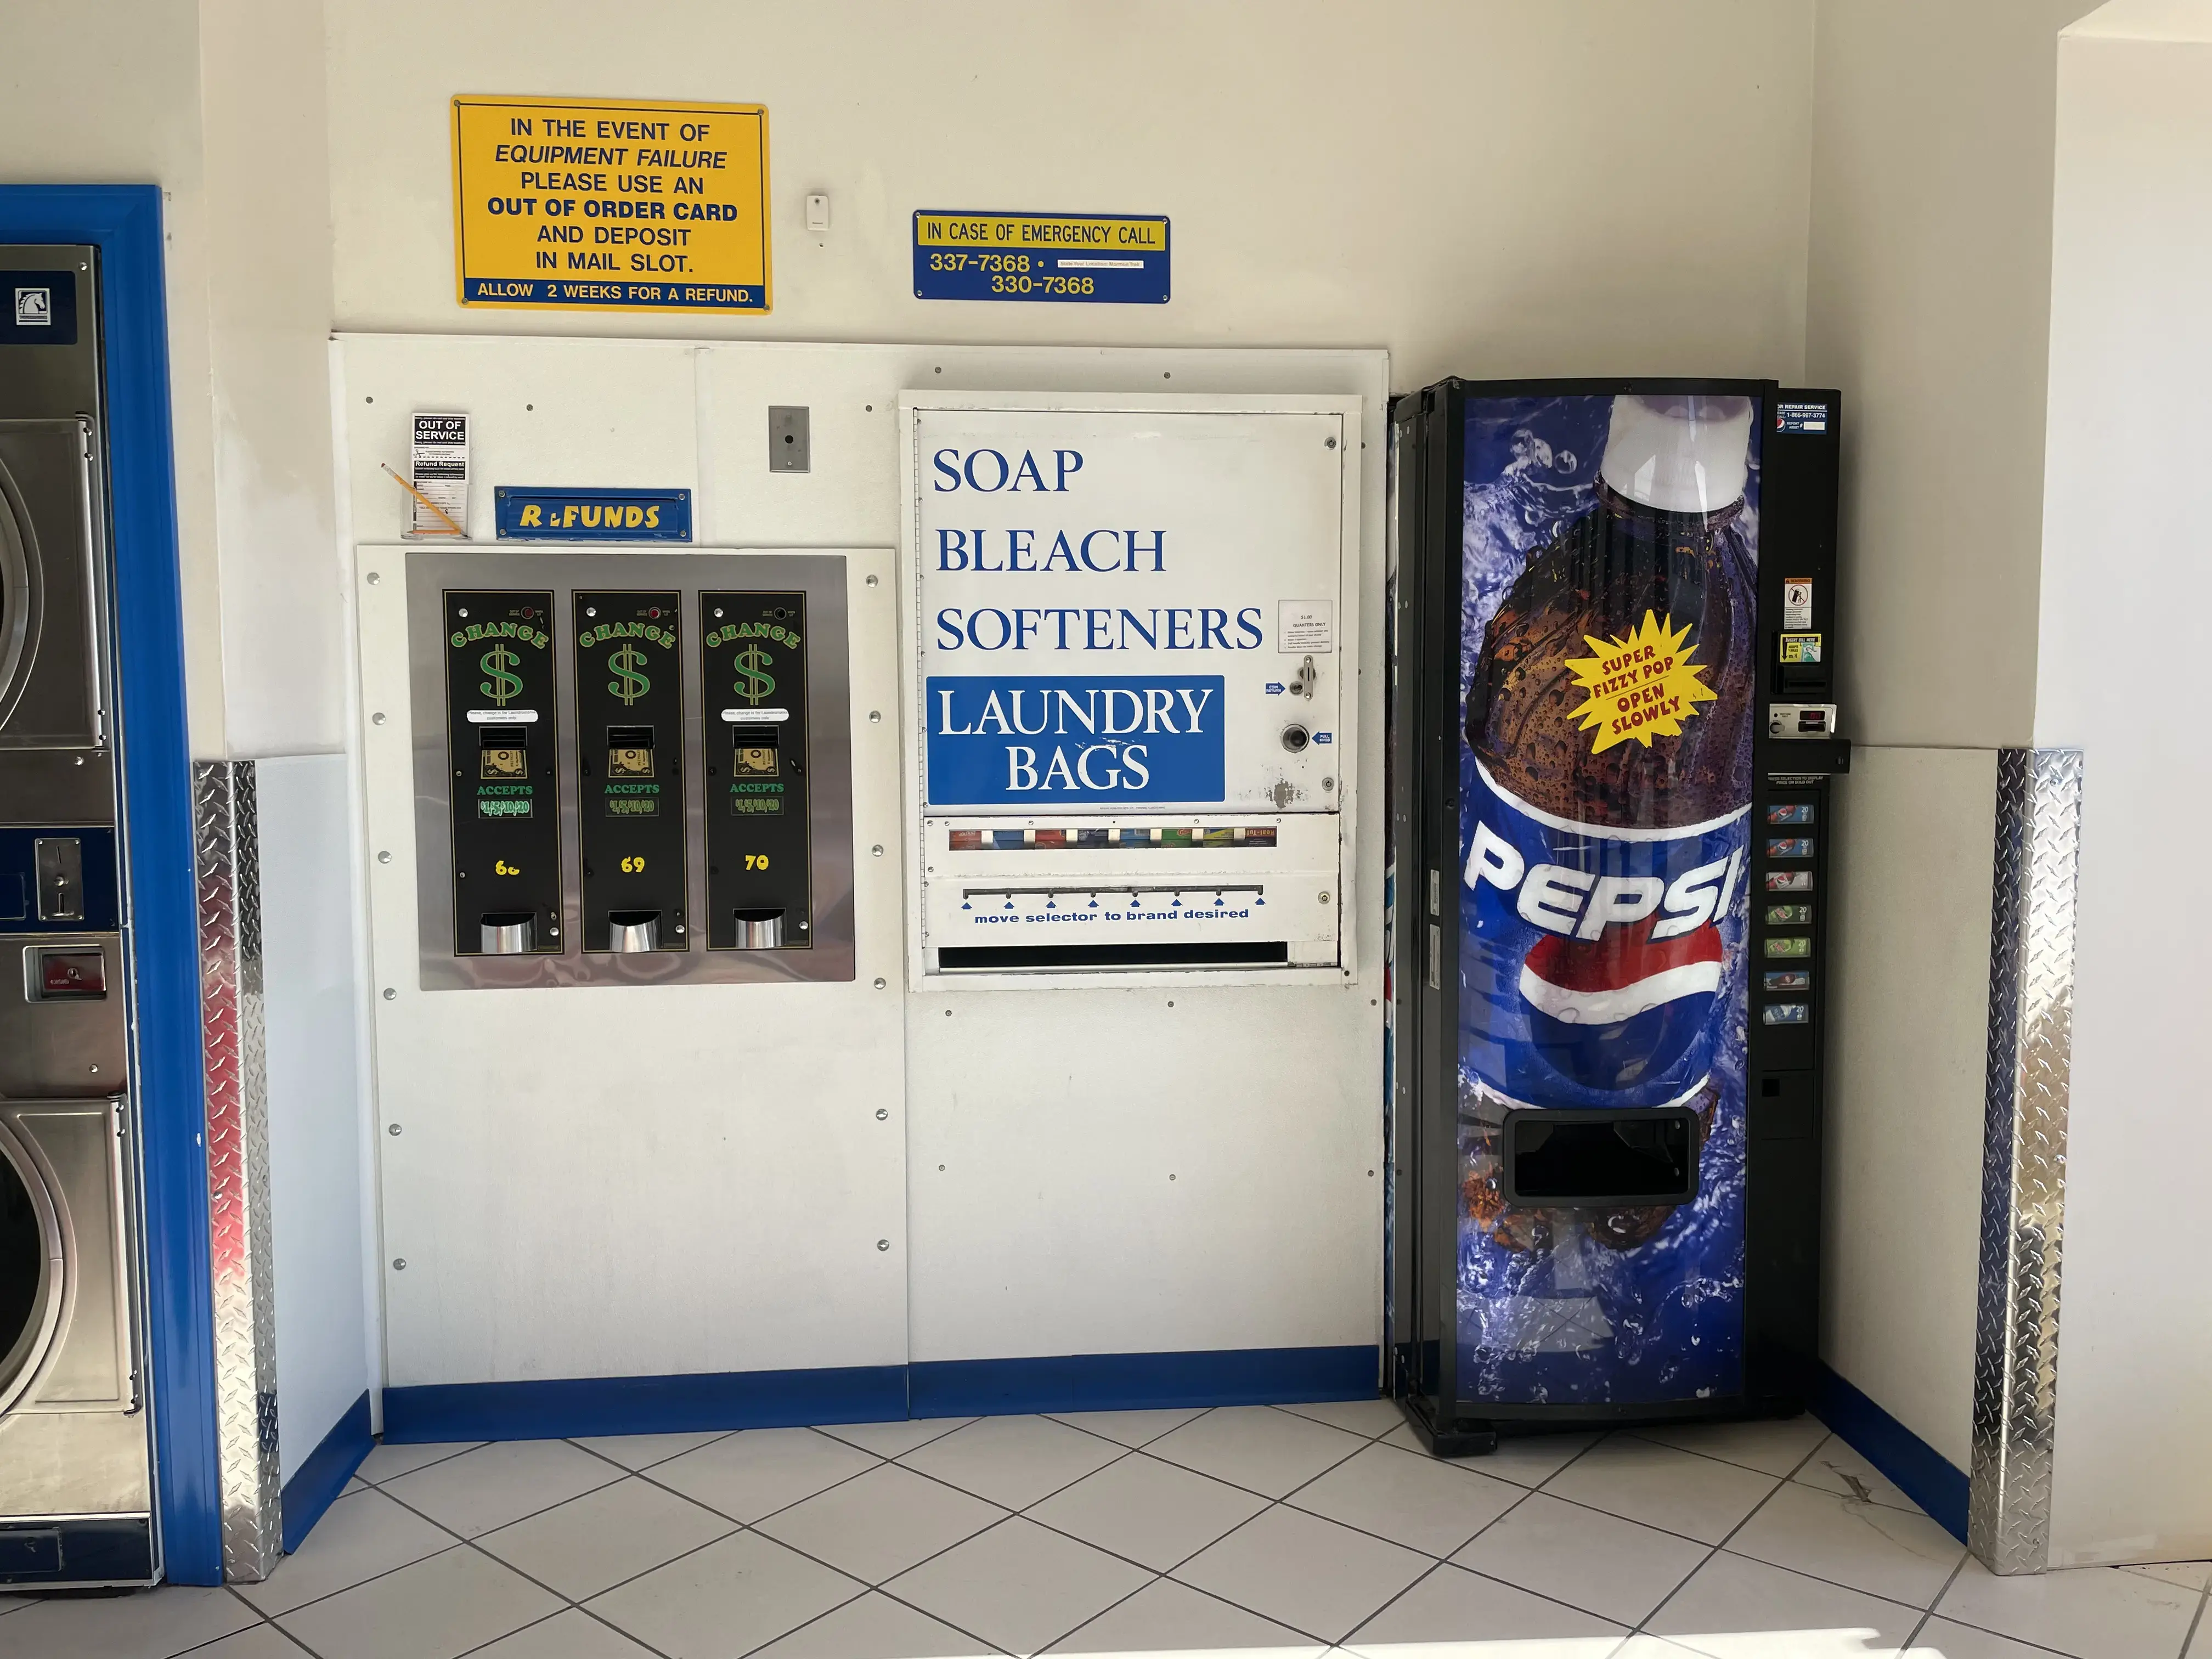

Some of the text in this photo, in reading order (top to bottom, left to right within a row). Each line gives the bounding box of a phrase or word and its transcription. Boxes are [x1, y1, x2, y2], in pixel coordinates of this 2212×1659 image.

[511, 118, 710, 142] IN THE EVENT OF
[495, 145, 727, 169] EQUIPMENT FAILURE
[522, 172, 703, 194] PLEASE USE AN
[488, 197, 737, 221] OUT OF ORDER CARD
[538, 225, 691, 246] AND DEPOSIT
[928, 222, 1155, 244] IN CASE OF EMERGENCY CALL
[537, 251, 693, 272] IN MAIL SLOT.
[930, 253, 1030, 273] 337-7368
[478, 284, 753, 302] ALLOW 2 WEEKS FOR A REFUND.
[991, 275, 1094, 294] 330-7368
[416, 431, 464, 439] SERVICE
[419, 421, 443, 429] OUT
[934, 449, 1084, 493] SOAP
[936, 529, 1166, 572] BLEACH
[451, 622, 549, 649] CHANGE
[579, 622, 675, 649] CHANGE
[706, 623, 801, 650] CHANGE
[937, 608, 1262, 650] SOFTENERS
[1602, 645, 1656, 675] SUPER
[1593, 657, 1673, 698] FIZZY POP
[1617, 684, 1664, 712] OPEN
[938, 689, 1214, 736] LAUNDRY
[1612, 696, 1679, 735] SLOWLY
[1006, 744, 1149, 791] BAGS
[476, 786, 533, 795] ACCEPTS
[605, 785, 659, 794] ACCEPTS
[730, 783, 784, 793] ACCEPTS
[621, 856, 645, 873] 69
[745, 855, 769, 871] 70
[1464, 820, 1743, 941] PEPSI
[974, 909, 1249, 924] move selector to brand desired
